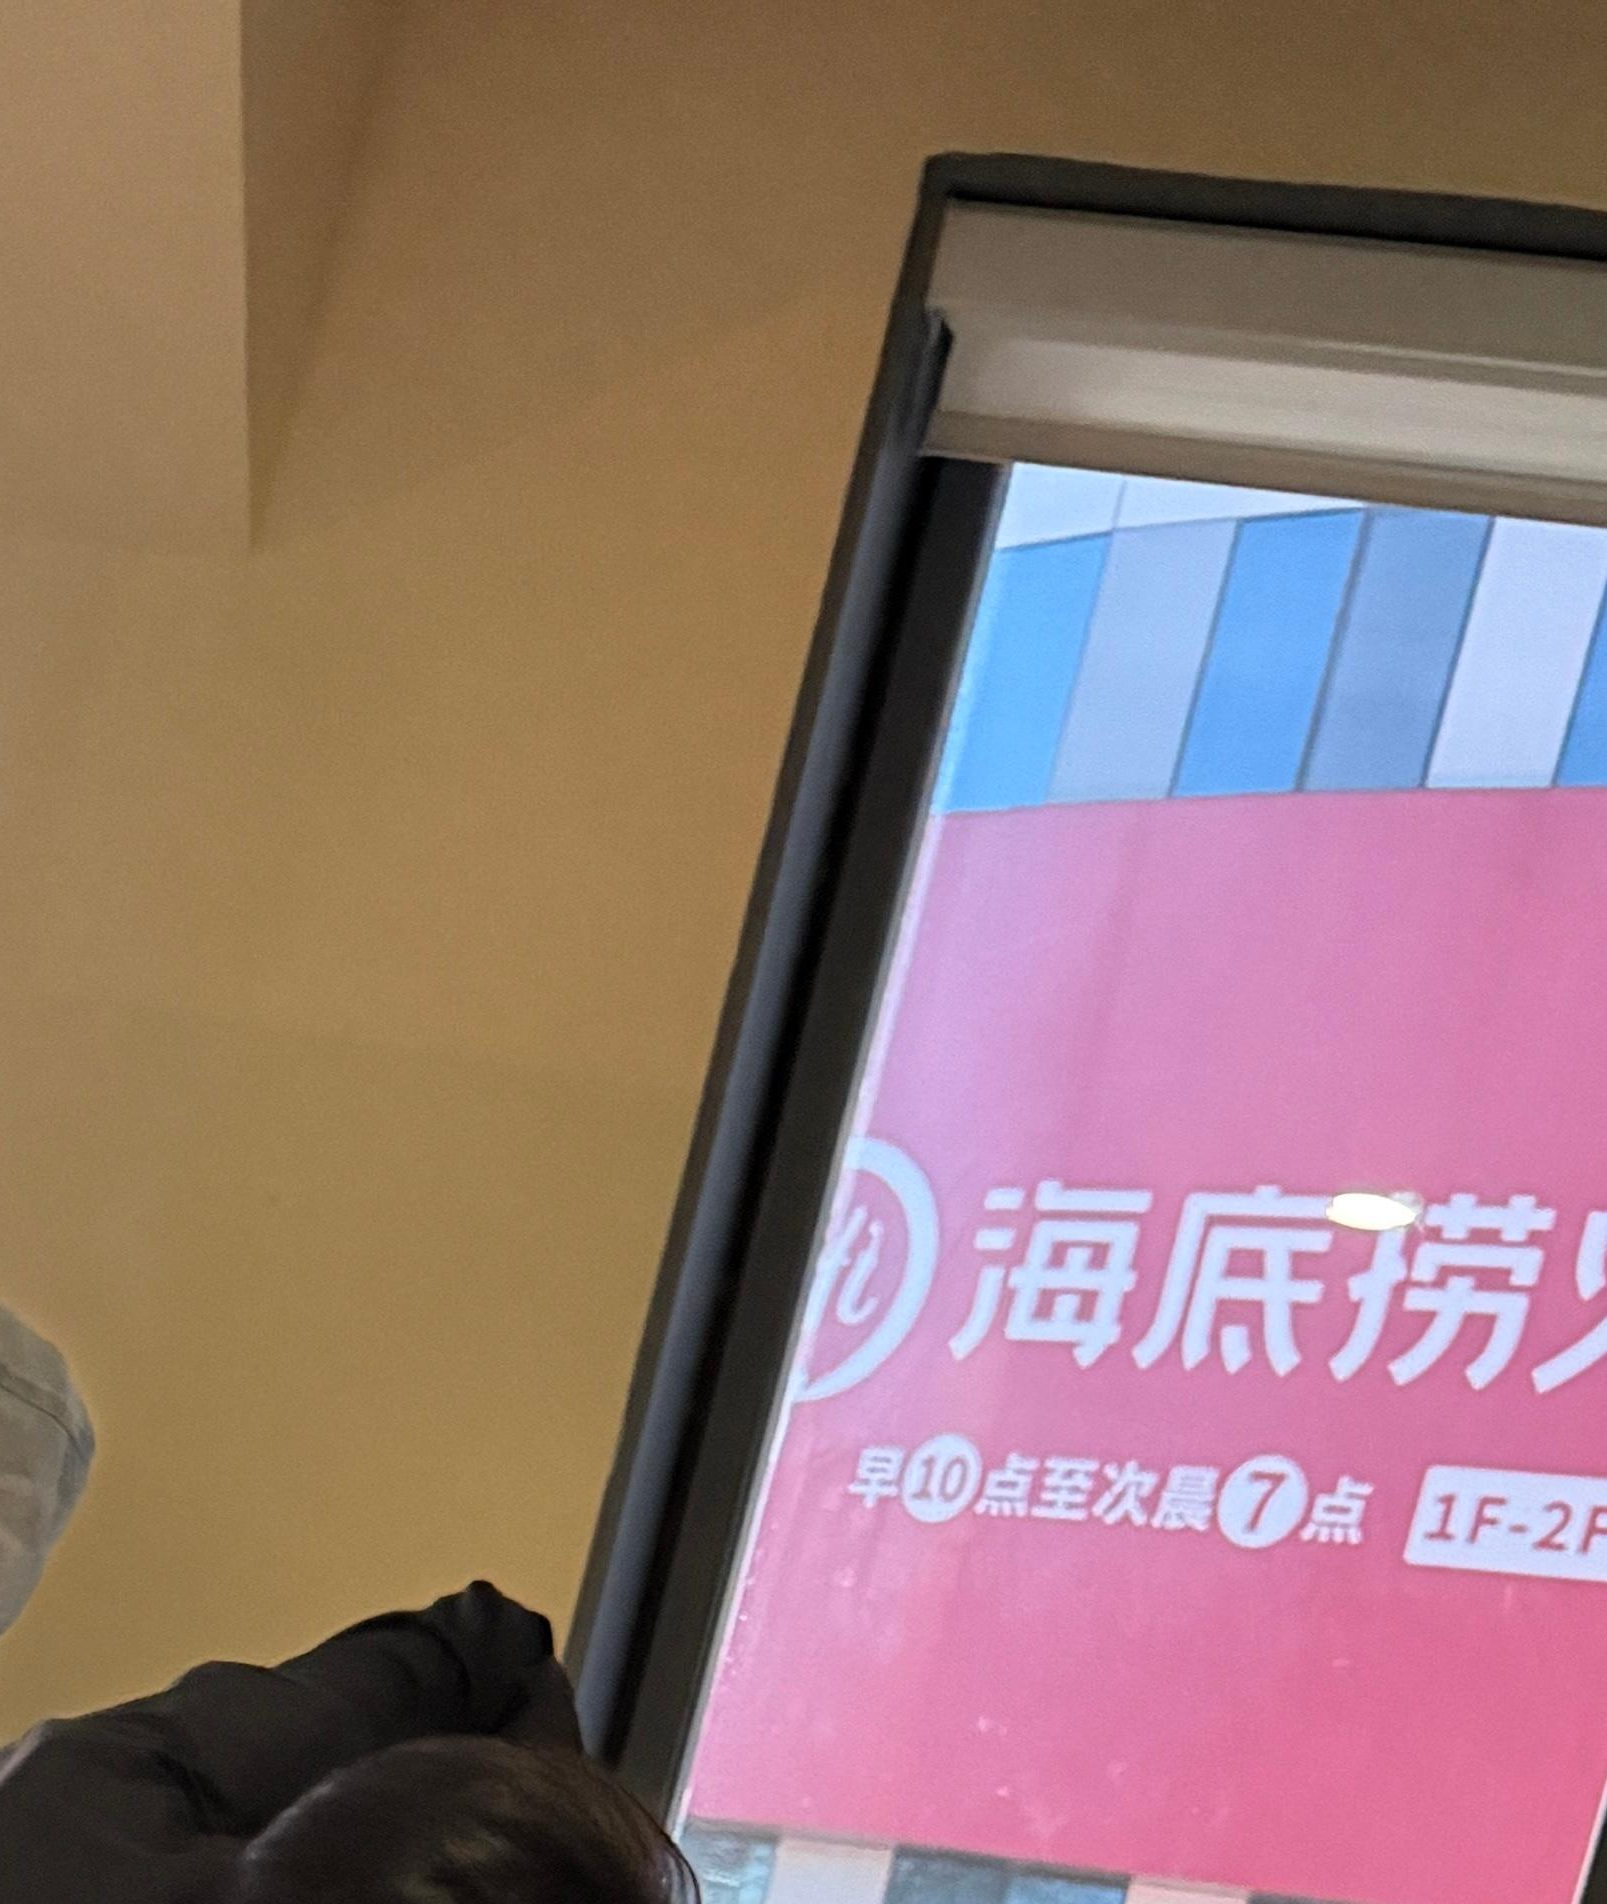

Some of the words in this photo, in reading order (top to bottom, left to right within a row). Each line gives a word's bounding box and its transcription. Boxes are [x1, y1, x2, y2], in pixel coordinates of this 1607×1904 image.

[847, 1436, 1376, 1548] 早10点至次晨7点
